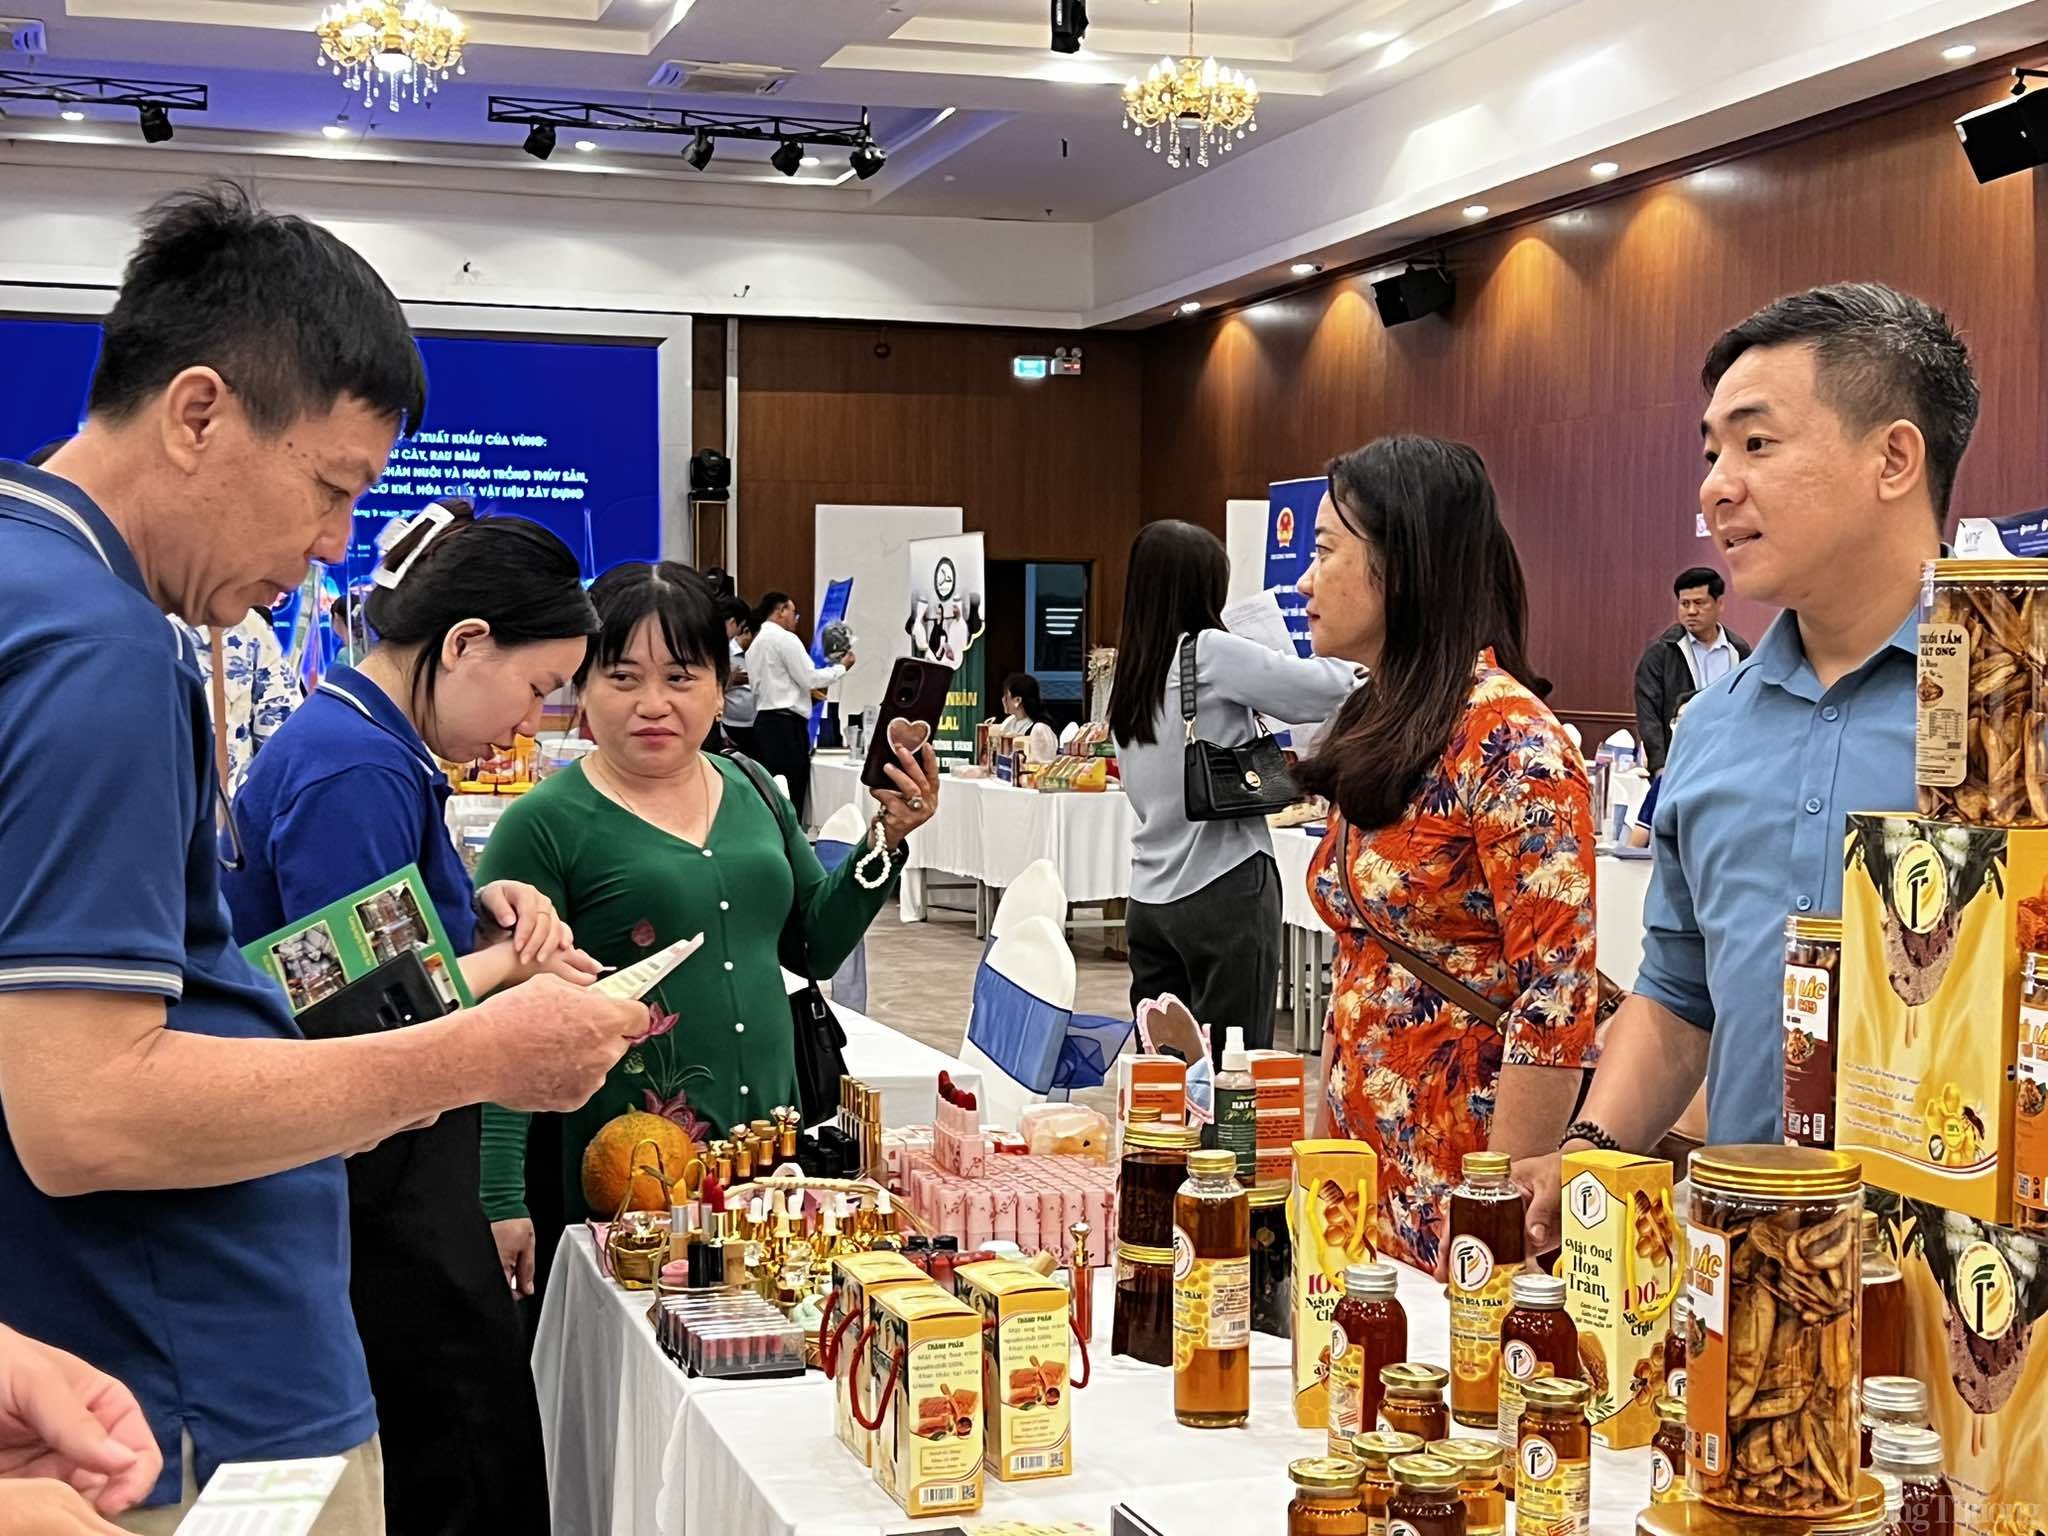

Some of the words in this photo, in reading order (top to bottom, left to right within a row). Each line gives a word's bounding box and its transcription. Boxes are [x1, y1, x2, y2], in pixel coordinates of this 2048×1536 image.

[421, 430, 449, 444] XUẤT
[485, 432, 510, 445] CỦA
[430, 450, 452, 461] RAU
[444, 466, 460, 479] VÀ
[937, 716, 960, 730] LAL
[1590, 1244, 1612, 1264] Ong
[1573, 1255, 1600, 1277] Hoa
[1568, 1273, 1610, 1303] Tràm
